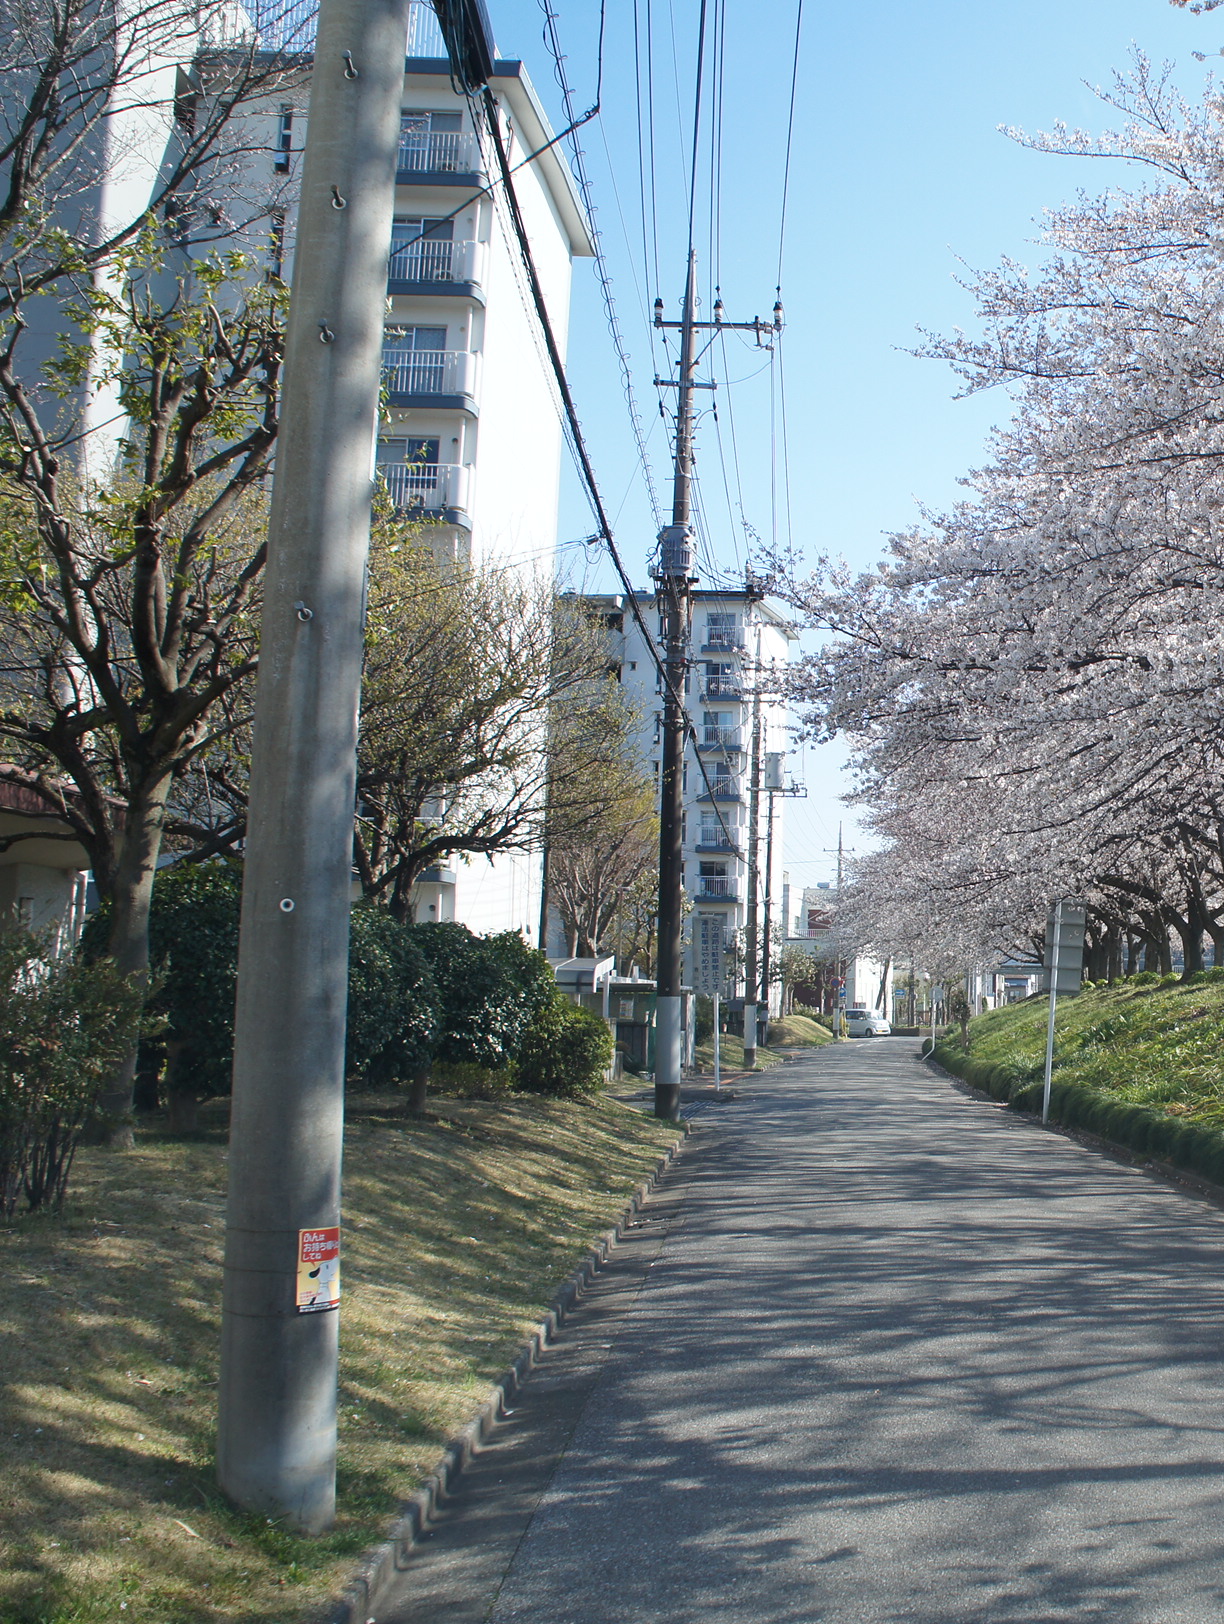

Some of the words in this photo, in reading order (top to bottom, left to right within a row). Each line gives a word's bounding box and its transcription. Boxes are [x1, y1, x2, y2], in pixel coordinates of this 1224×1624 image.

[712, 919, 720, 990] この道路は駐車禁止です
[302, 1252, 322, 1261] してね
